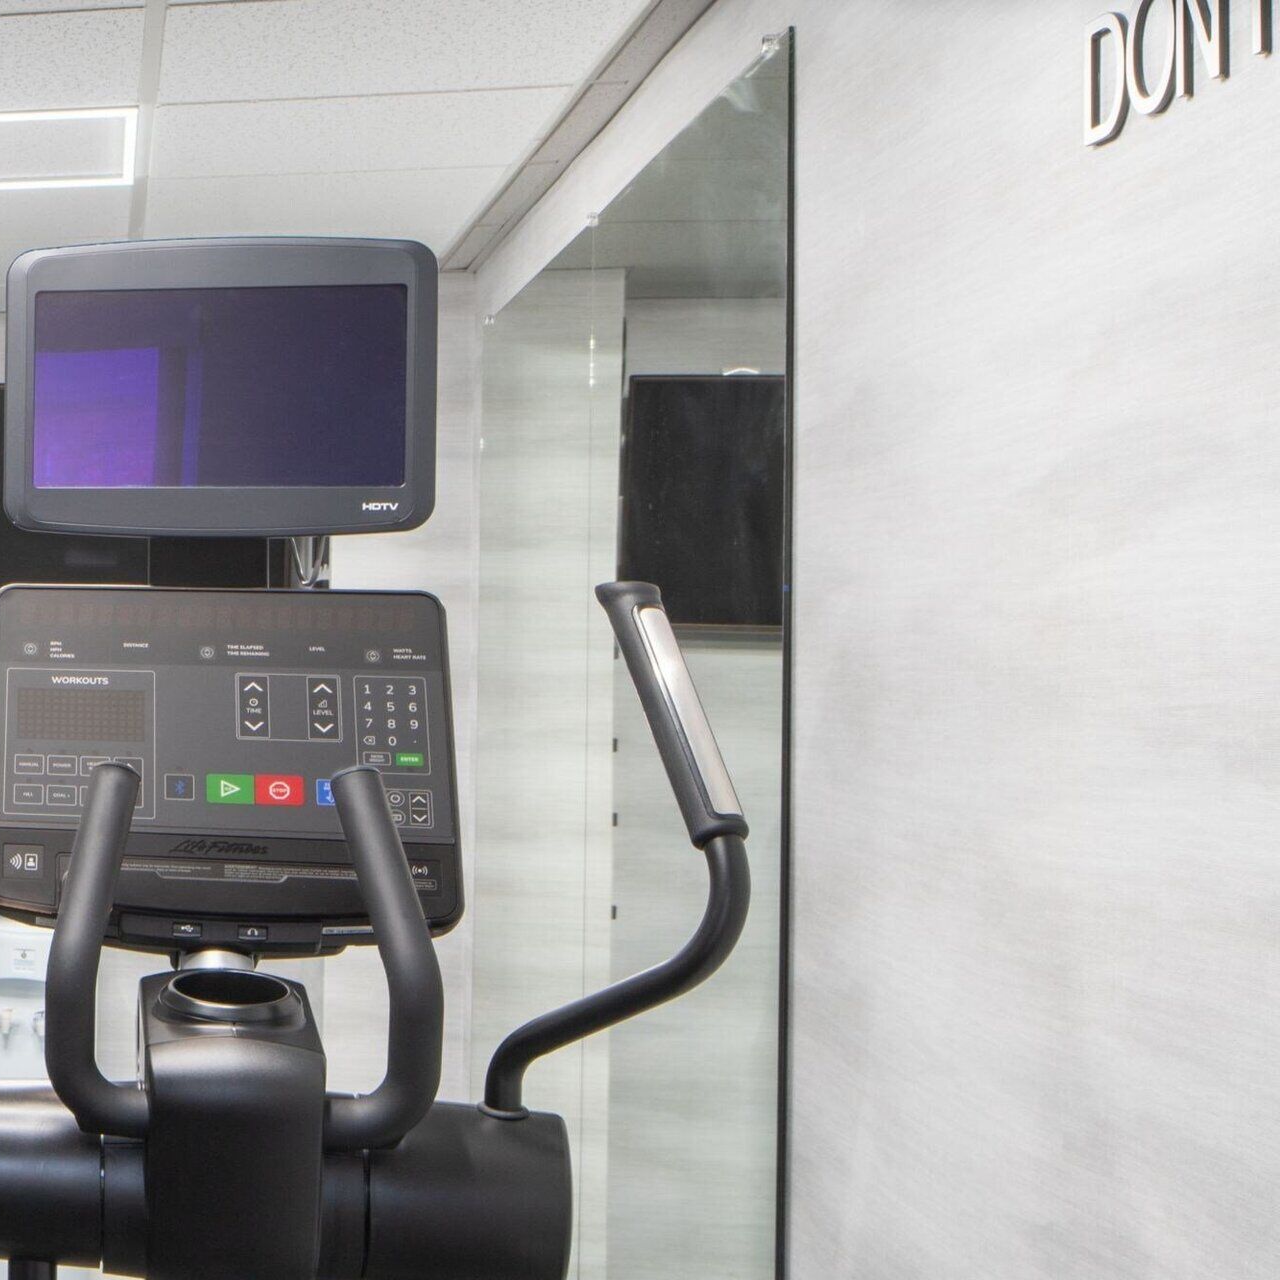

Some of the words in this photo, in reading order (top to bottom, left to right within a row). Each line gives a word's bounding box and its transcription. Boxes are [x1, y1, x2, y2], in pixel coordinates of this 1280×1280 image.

[361, 502, 399, 511] HDTV
[51, 676, 109, 686] WORKOUTS
[364, 685, 372, 694] 1
[386, 685, 394, 695] 2
[408, 685, 417, 695] 3
[363, 701, 372, 711] 4
[387, 702, 395, 712] 5
[408, 702, 417, 712] 6
[365, 718, 373, 728] 7
[387, 719, 396, 729] 8
[410, 719, 418, 729] 9
[388, 736, 397, 746] 0
